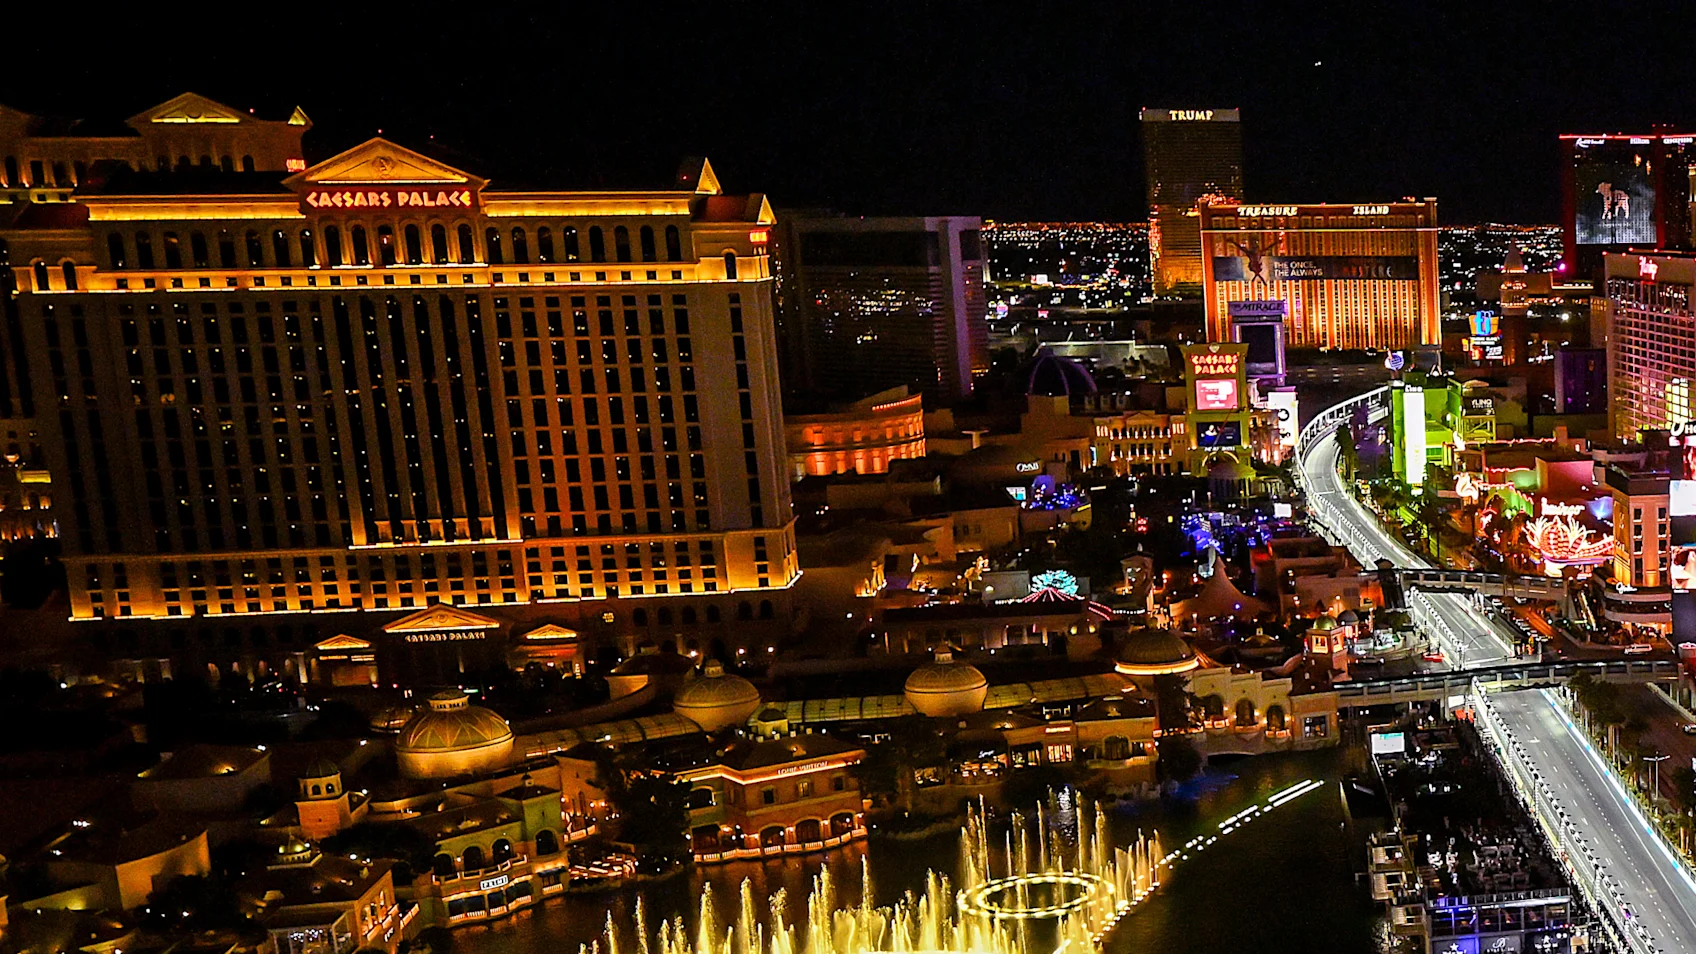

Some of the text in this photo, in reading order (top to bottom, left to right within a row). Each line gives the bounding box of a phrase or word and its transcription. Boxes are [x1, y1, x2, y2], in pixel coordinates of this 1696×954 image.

[1169, 110, 1214, 121] TRUMP
[306, 190, 472, 208] CAESARS PALACE
[1237, 206, 1390, 217] TREASURE ISLAND
[1273, 261, 1289, 269] THE
[1274, 268, 1323, 277] THE ALWAYS
[1240, 303, 1283, 311] MIRAGE
[1192, 354, 1239, 365] CAESARS
[1195, 364, 1237, 375] PALACE
